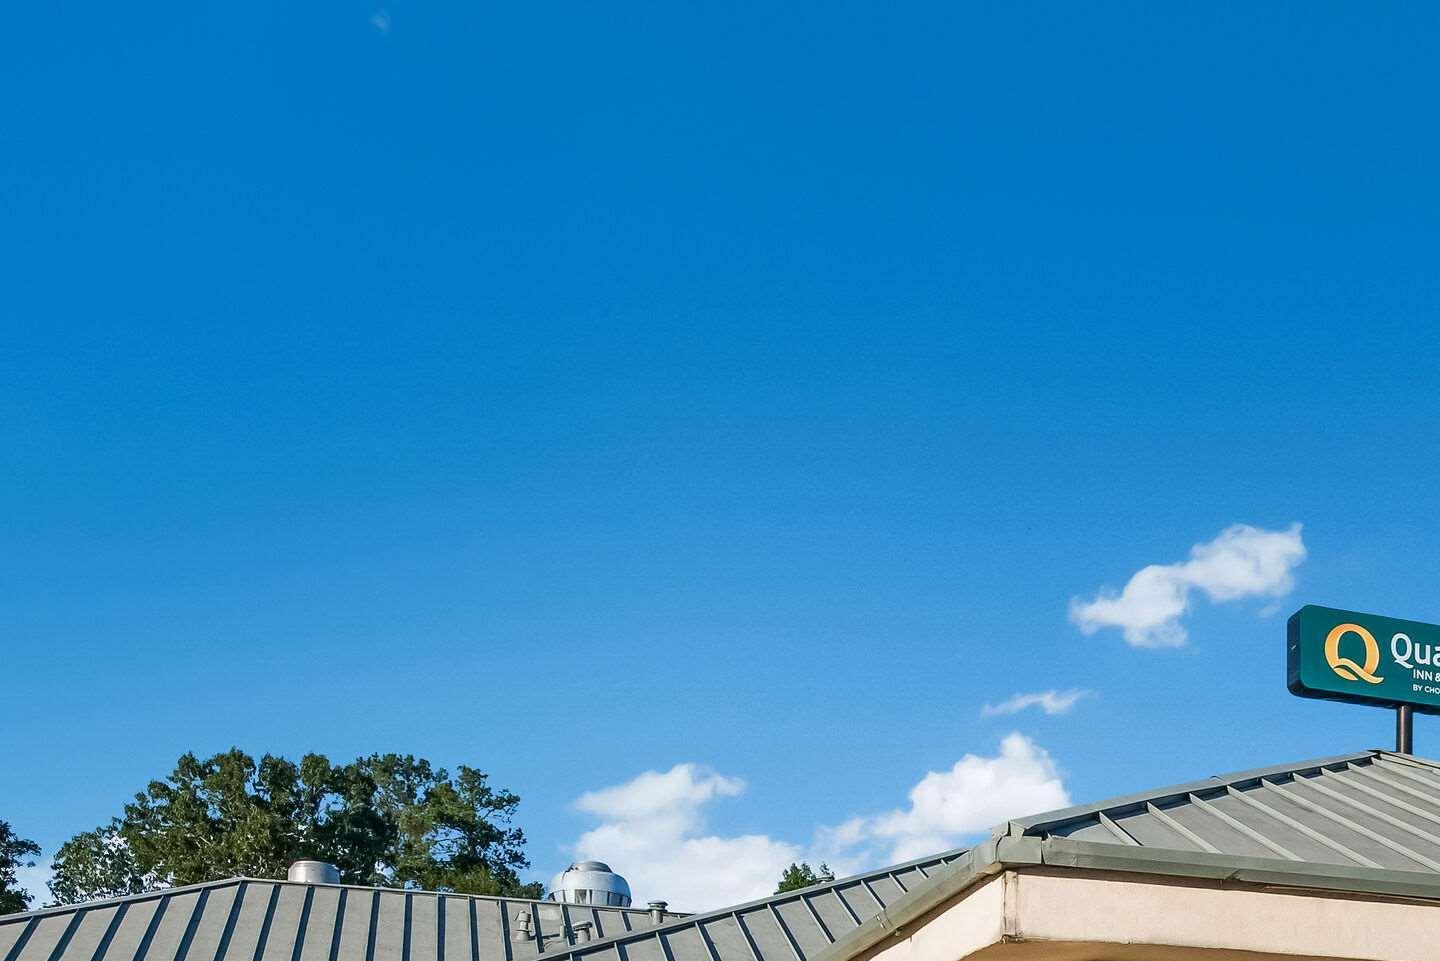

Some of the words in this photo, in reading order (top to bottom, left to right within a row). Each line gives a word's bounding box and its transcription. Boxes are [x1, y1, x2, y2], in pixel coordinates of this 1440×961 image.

[1324, 623, 1385, 684] Q
[1412, 668, 1433, 681] INN
[1412, 683, 1423, 692] BY
